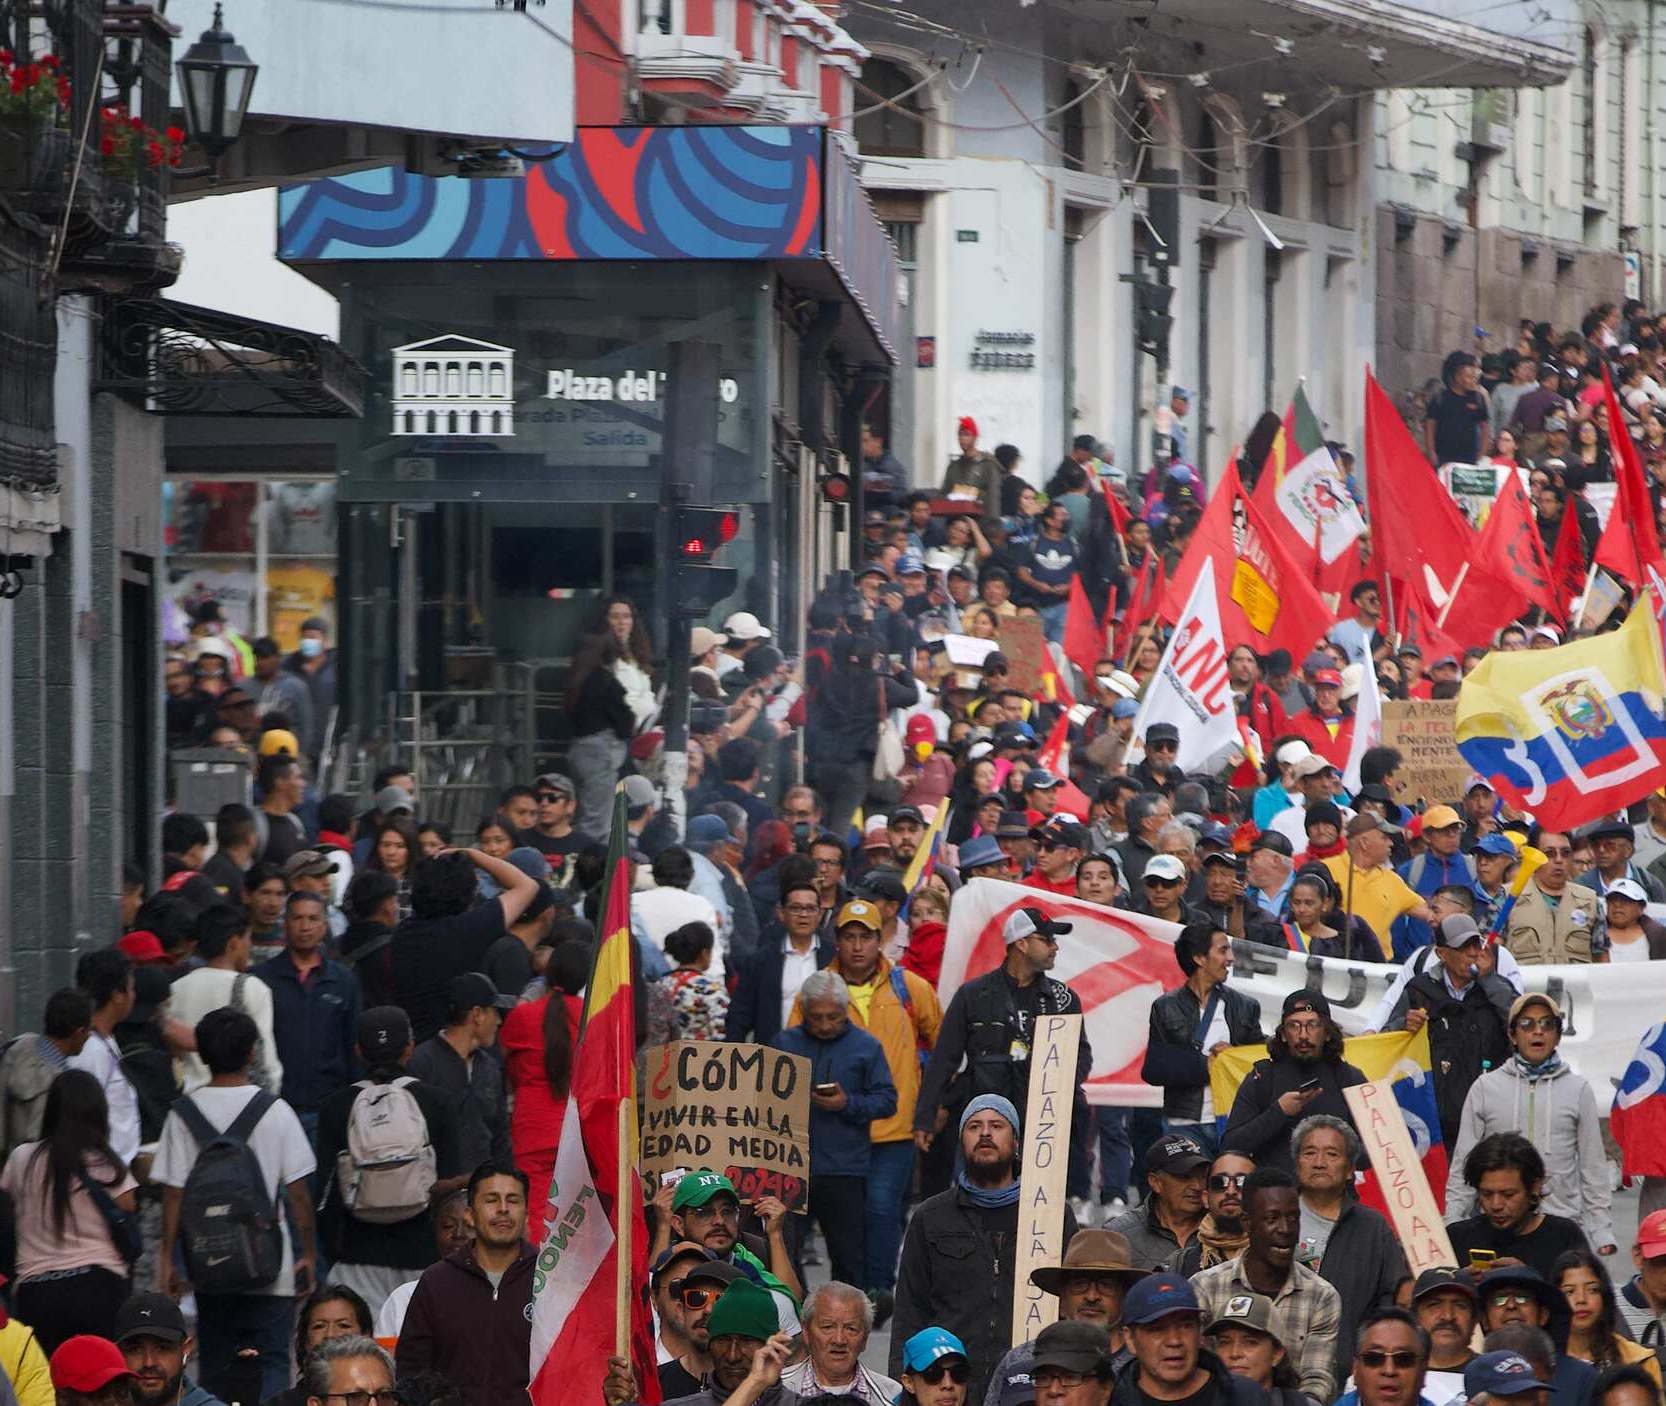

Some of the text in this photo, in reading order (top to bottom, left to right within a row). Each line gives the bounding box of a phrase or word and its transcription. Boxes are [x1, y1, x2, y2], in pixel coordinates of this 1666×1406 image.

[547, 368, 612, 401] Plaza
[617, 369, 656, 402] del
[583, 429, 647, 446] Salida
[1424, 721, 1455, 733] TEL
[1034, 1016, 1067, 1169] PALAZO
[648, 1104, 794, 1139] VIVIR EN LA
[642, 1132, 804, 1168] EDAD MEDIA
[1358, 1084, 1416, 1209] PALAZO
[1412, 1215, 1432, 1238] A
[698, 1174, 721, 1188] NY
[1033, 1186, 1048, 1208] A
[1030, 1219, 1047, 1258] LA
